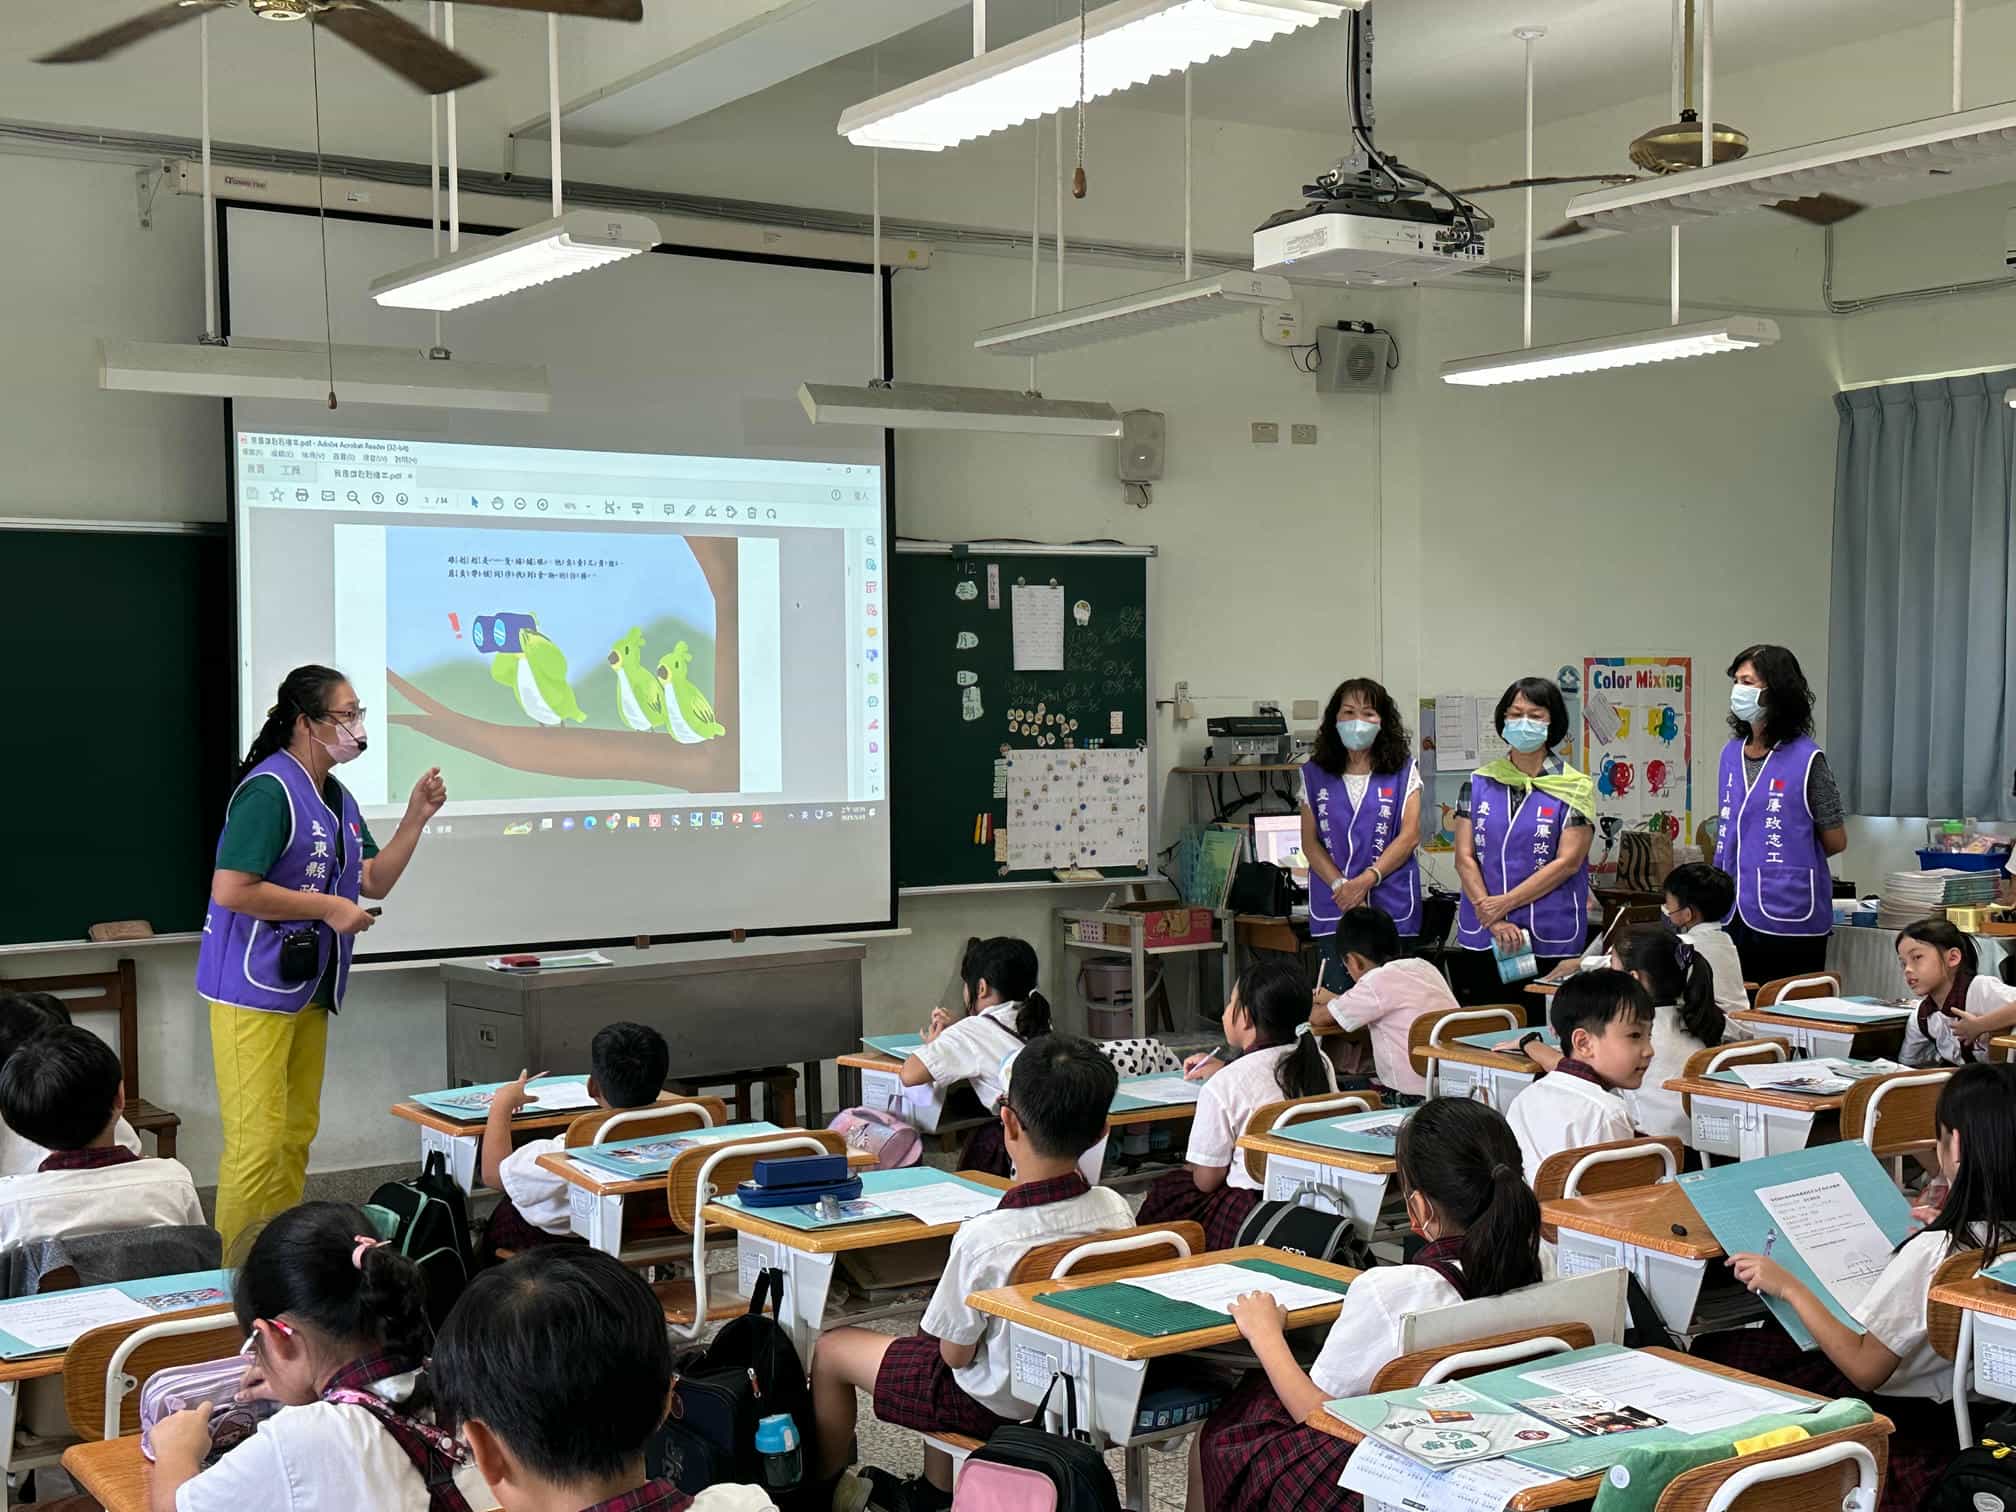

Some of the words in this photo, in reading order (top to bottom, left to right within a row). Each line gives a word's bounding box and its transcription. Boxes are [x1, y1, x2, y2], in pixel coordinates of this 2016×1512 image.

[1593, 670, 1632, 689] Color
[1635, 669, 1684, 692] Mixing
[1764, 797, 1784, 864] 廉政志工
